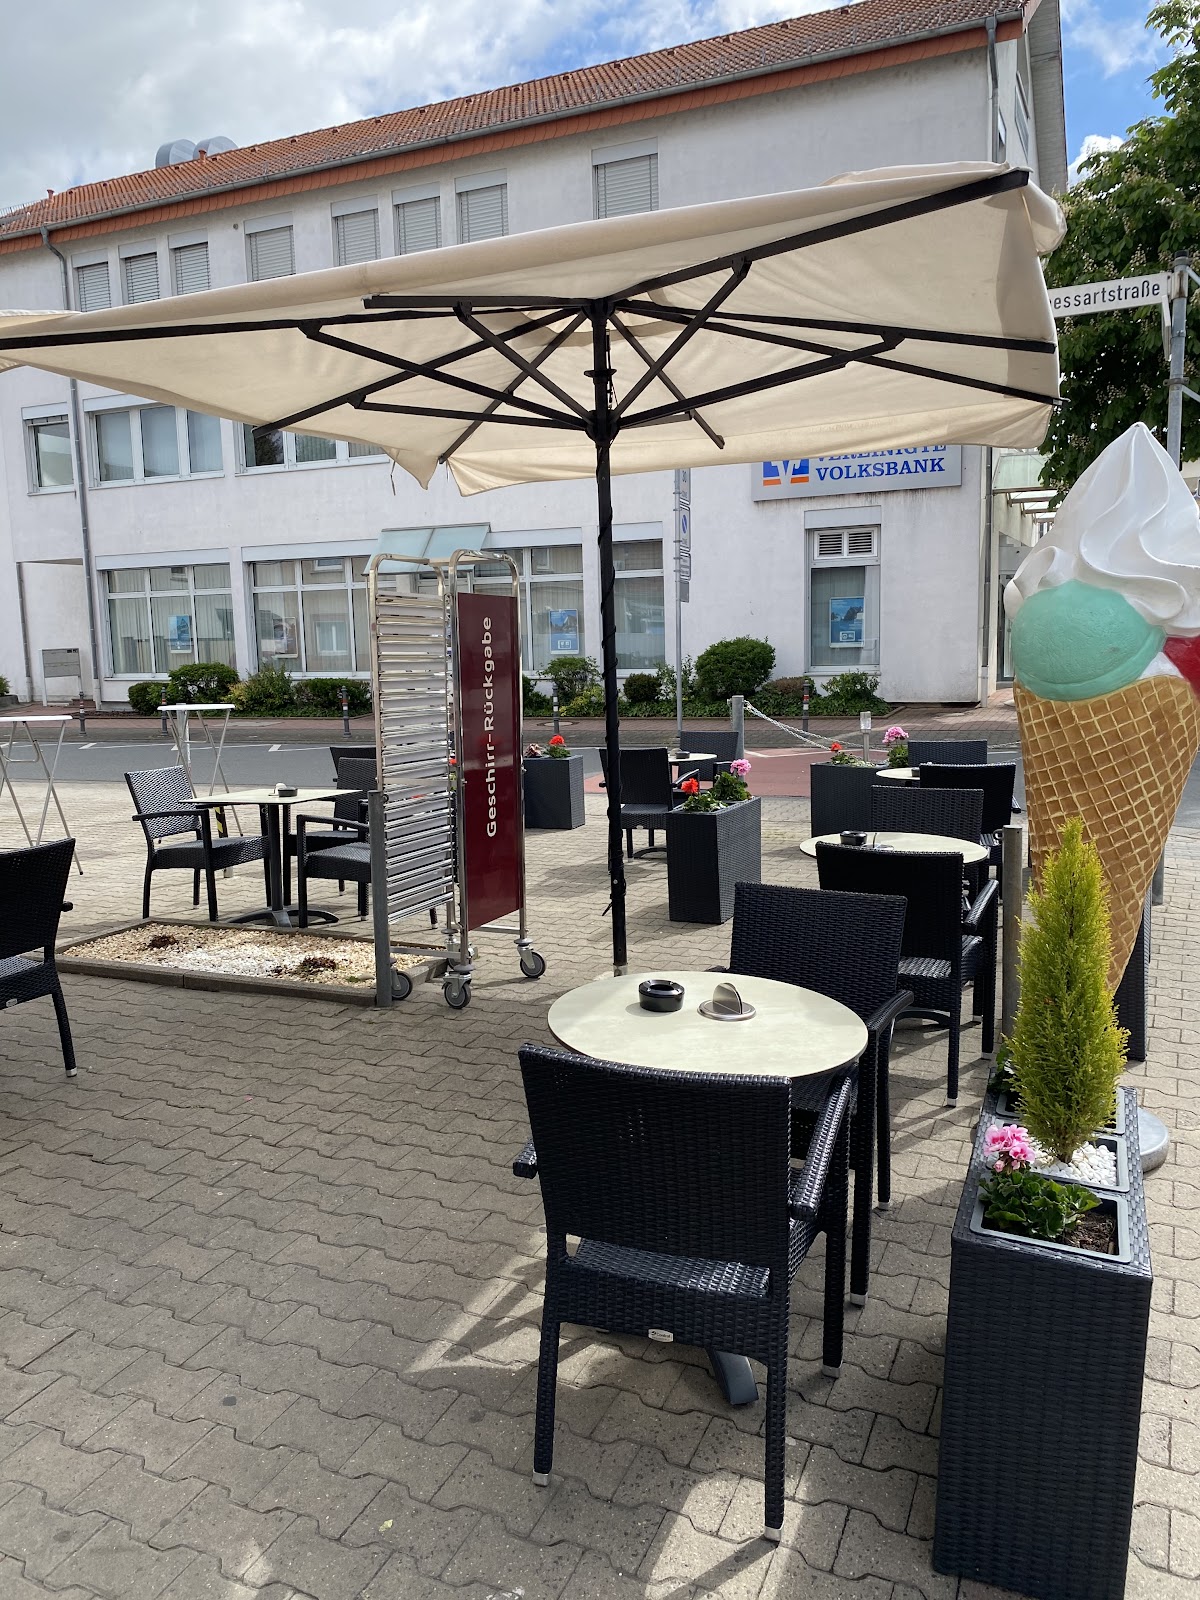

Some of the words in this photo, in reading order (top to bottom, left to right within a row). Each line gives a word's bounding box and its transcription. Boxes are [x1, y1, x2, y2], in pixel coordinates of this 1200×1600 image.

[1051, 280, 1160, 309] essartstraße
[816, 457, 945, 481] VOLKSBANK
[481, 616, 497, 837] Geschirr-Rückgabe
